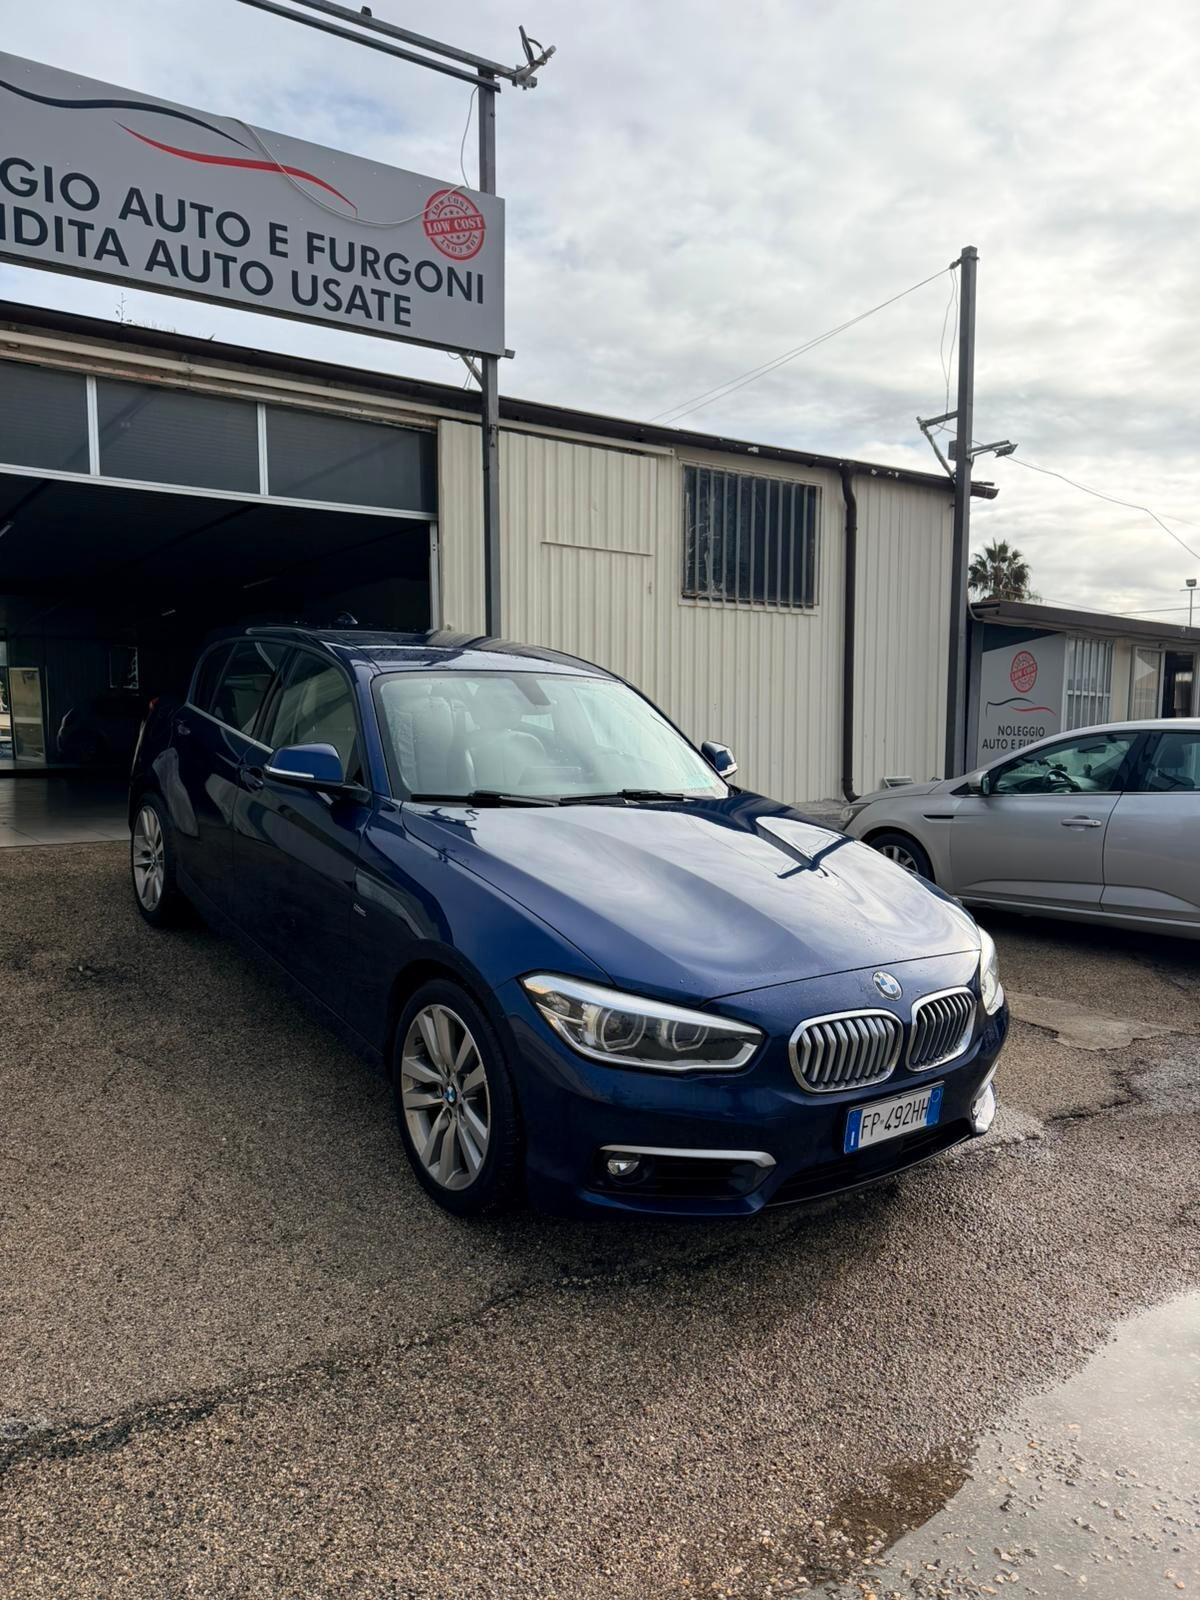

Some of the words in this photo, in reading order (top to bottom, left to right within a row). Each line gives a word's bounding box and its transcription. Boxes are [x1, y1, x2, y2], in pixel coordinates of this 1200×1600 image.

[0, 157, 100, 211] GIO
[119, 186, 250, 247] AUTO
[269, 222, 289, 258] E
[307, 232, 484, 304] FURGONI
[426, 220, 451, 234] LOW
[454, 217, 482, 231] COST
[145, 239, 273, 296] AUTO
[291, 270, 412, 327] USATE
[997, 725, 1045, 737] NOLEGGIO
[982, 738, 1008, 749] AUTO
[1011, 739, 1015, 749] E
